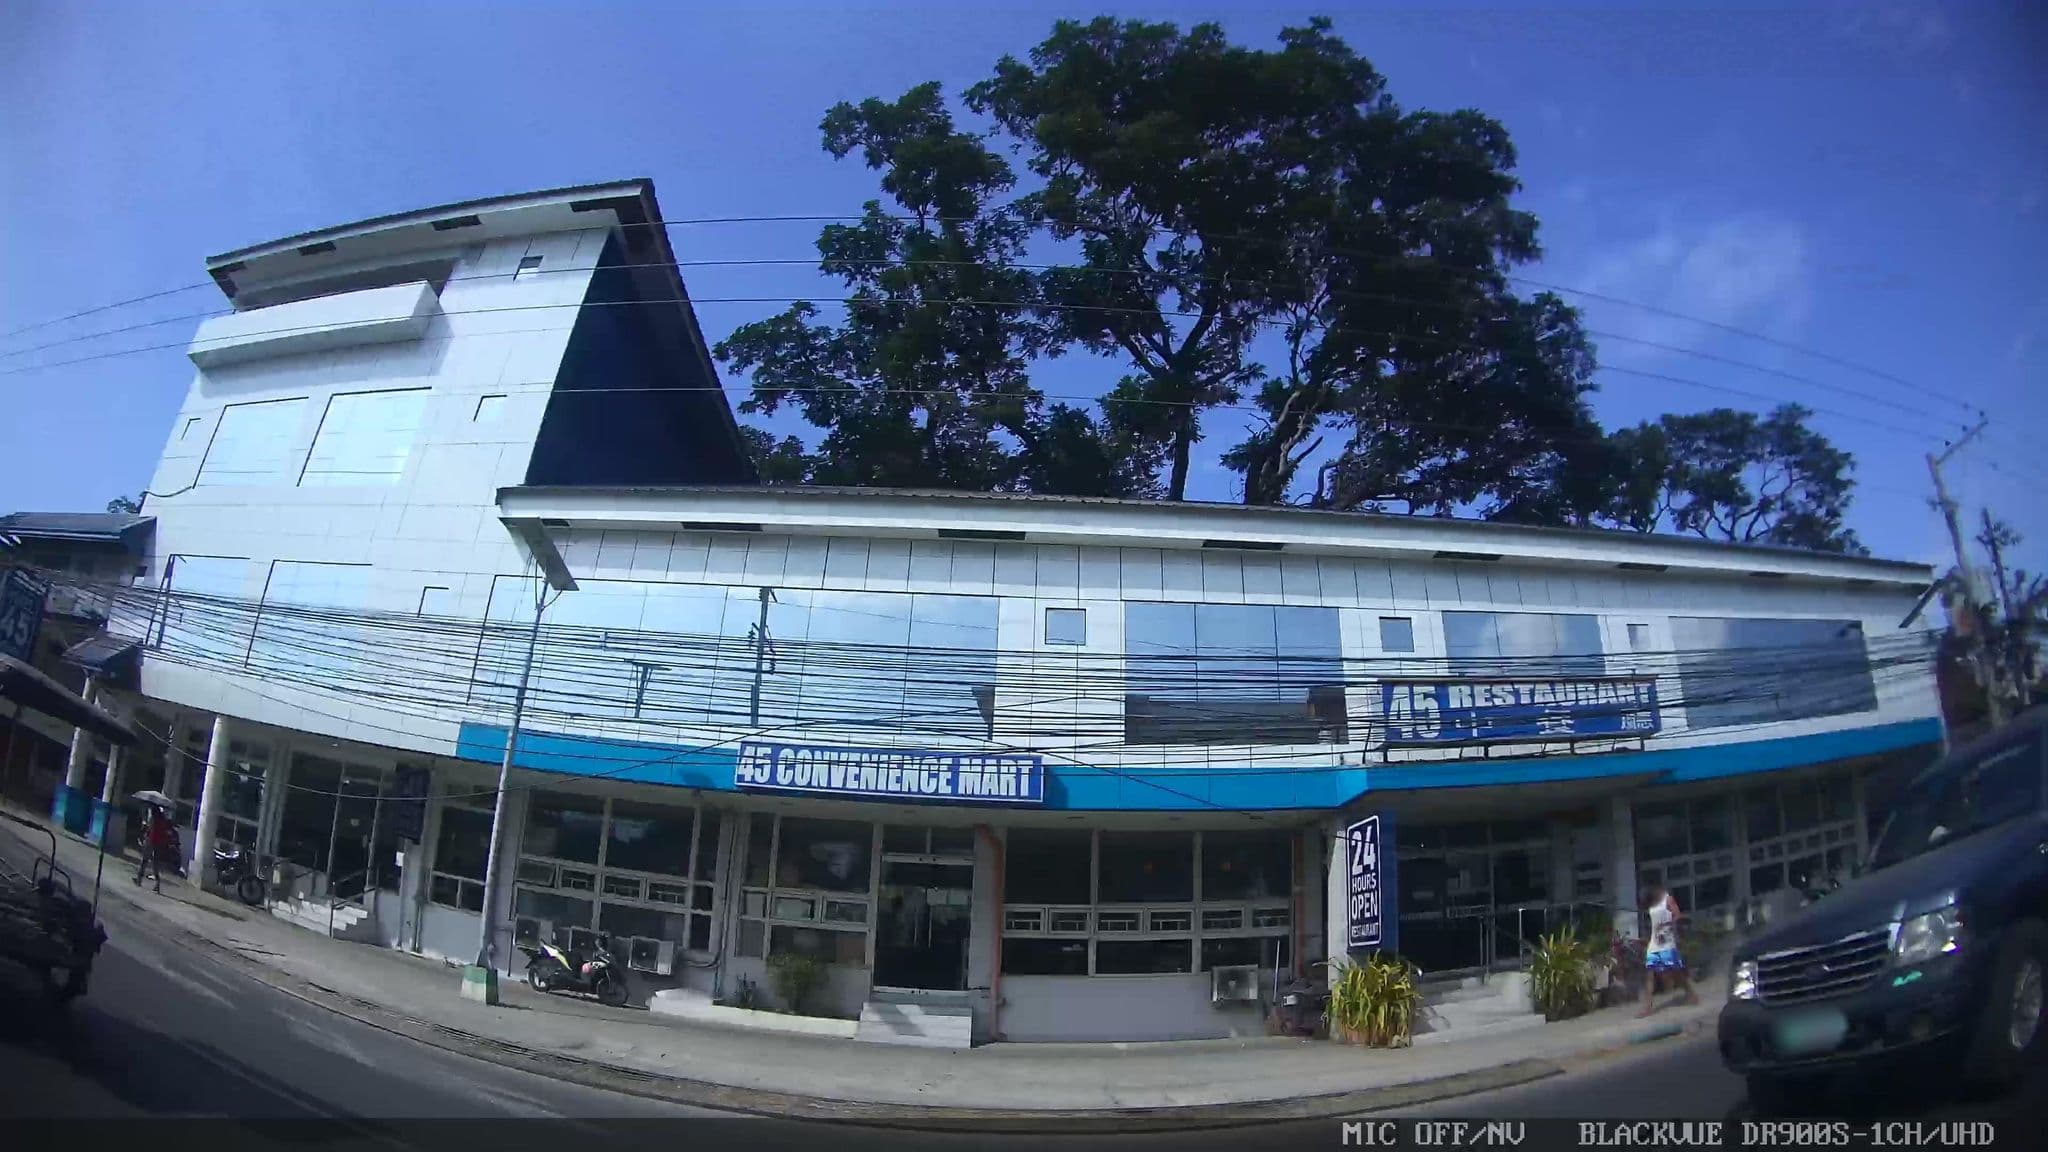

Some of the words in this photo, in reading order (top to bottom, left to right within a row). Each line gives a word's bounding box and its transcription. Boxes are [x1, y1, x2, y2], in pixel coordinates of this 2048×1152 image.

[1389, 683, 1440, 738] 45
[1448, 682, 1653, 706] RESTAURANT
[738, 746, 771, 783] 45
[776, 749, 952, 793] CONVENIENCE
[958, 758, 1034, 795] MART
[1351, 825, 1376, 875] 24
[1351, 890, 1378, 920] OPEN
[1352, 873, 1376, 893] HOURS
